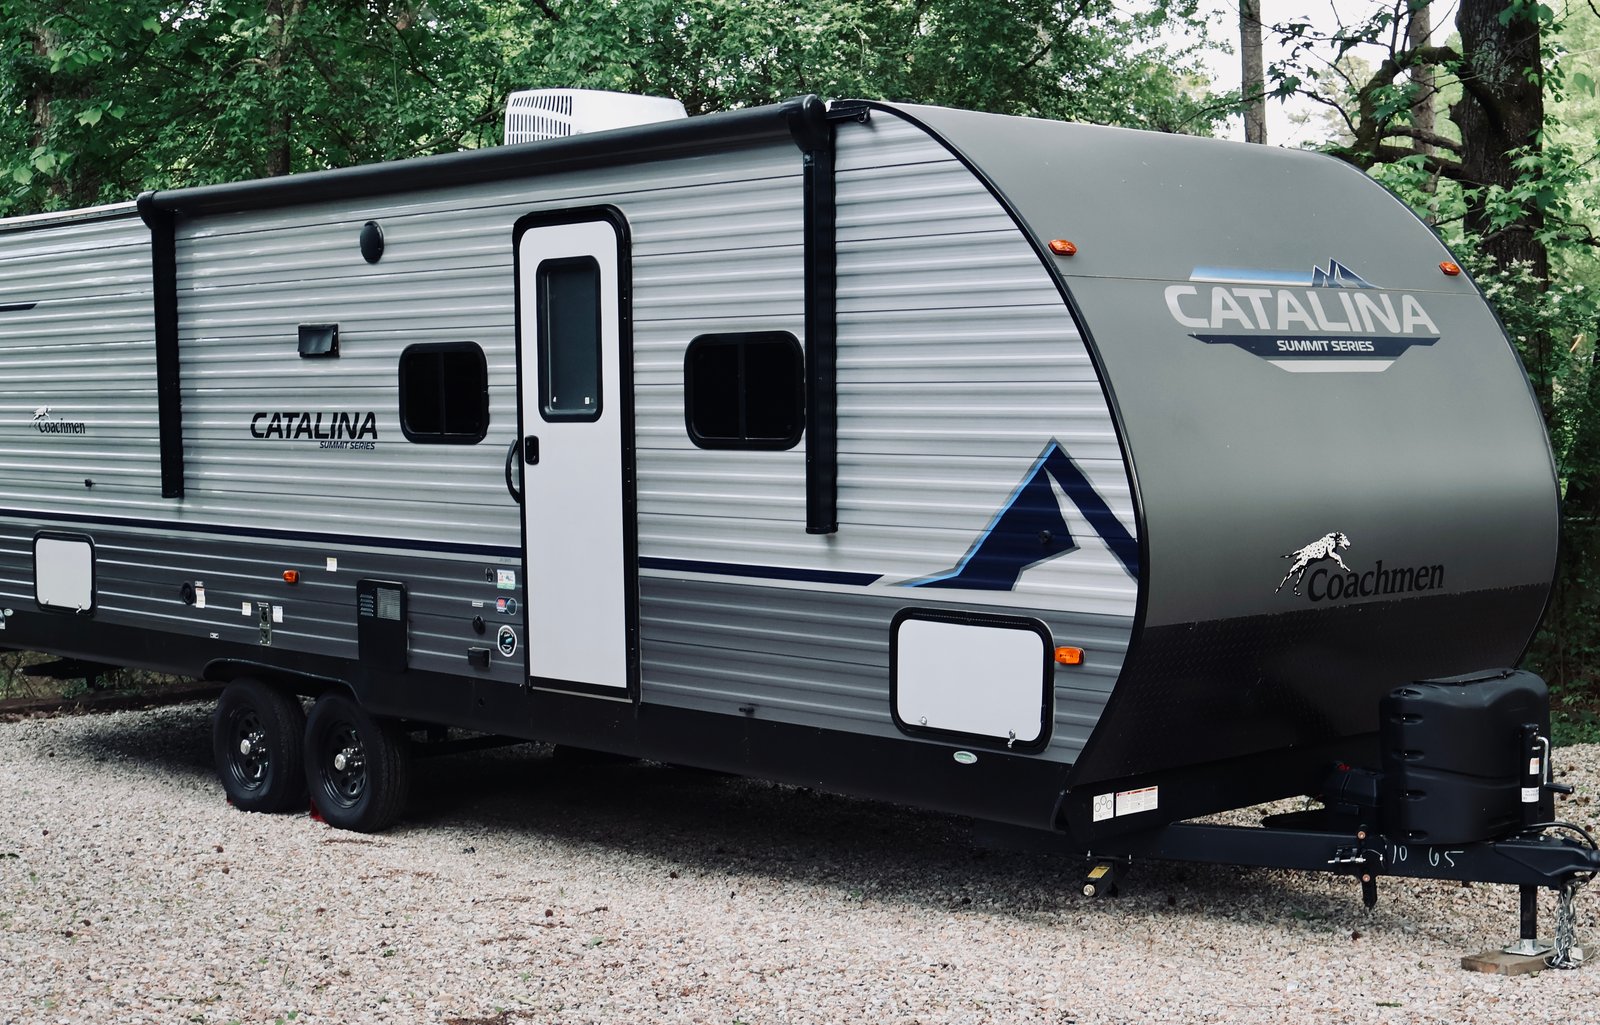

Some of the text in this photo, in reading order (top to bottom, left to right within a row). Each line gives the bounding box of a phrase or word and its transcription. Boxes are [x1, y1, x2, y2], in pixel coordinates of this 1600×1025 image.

[1164, 285, 1440, 335] CATALINA
[1276, 340, 1375, 352] SUMMIT SERIES
[38, 417, 86, 434] Coachmen
[250, 411, 378, 440] CATALINA
[319, 440, 376, 450] SUMMIT SERIES
[1307, 560, 1444, 602] Coachmen
[1428, 847, 1465, 868] 65
